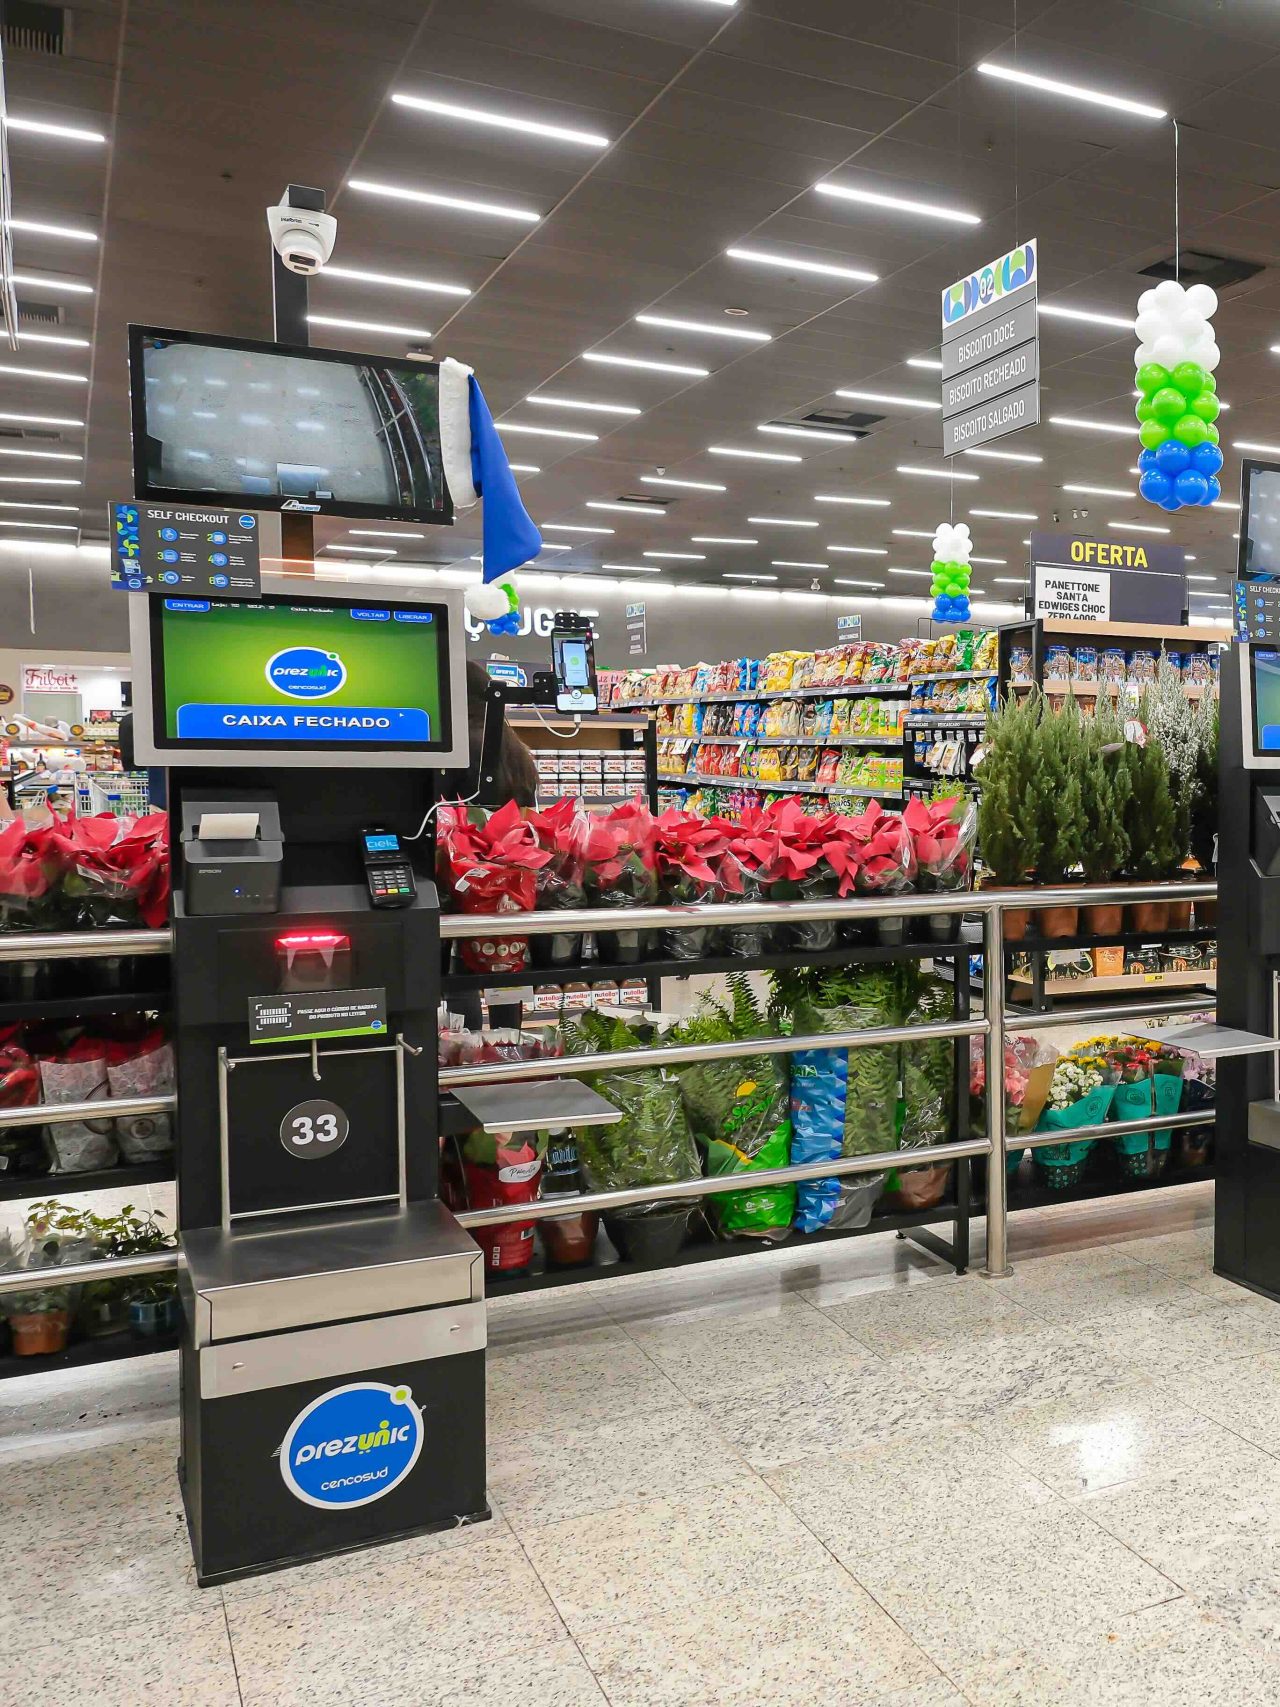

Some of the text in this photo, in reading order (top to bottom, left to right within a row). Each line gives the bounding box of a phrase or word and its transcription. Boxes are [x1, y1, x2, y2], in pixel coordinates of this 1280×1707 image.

[979, 274, 994, 298] 02
[958, 320, 1015, 363] BISCOITO DOCE
[949, 356, 1026, 406] BISCOITO RECHEADO
[954, 399, 1025, 443] BISCOITO SALGADO
[147, 509, 230, 524] SELF CHECKOUT
[207, 533, 213, 542] 2
[1071, 541, 1148, 568] OFERTA
[1045, 580, 1100, 593] PANETTONE
[1250, 585, 1262, 593] SELF
[1056, 592, 1088, 602] SANTA
[1039, 600, 1106, 614] EDWIGES CHOC
[1048, 611, 1096, 621] ZERO 400G
[273, 665, 339, 677] prezunic
[223, 715, 390, 728] CAIXA FECHADO
[291, 1114, 339, 1146] 33
[295, 1420, 410, 1465] prezunic
[321, 1466, 388, 1491] cencosud
